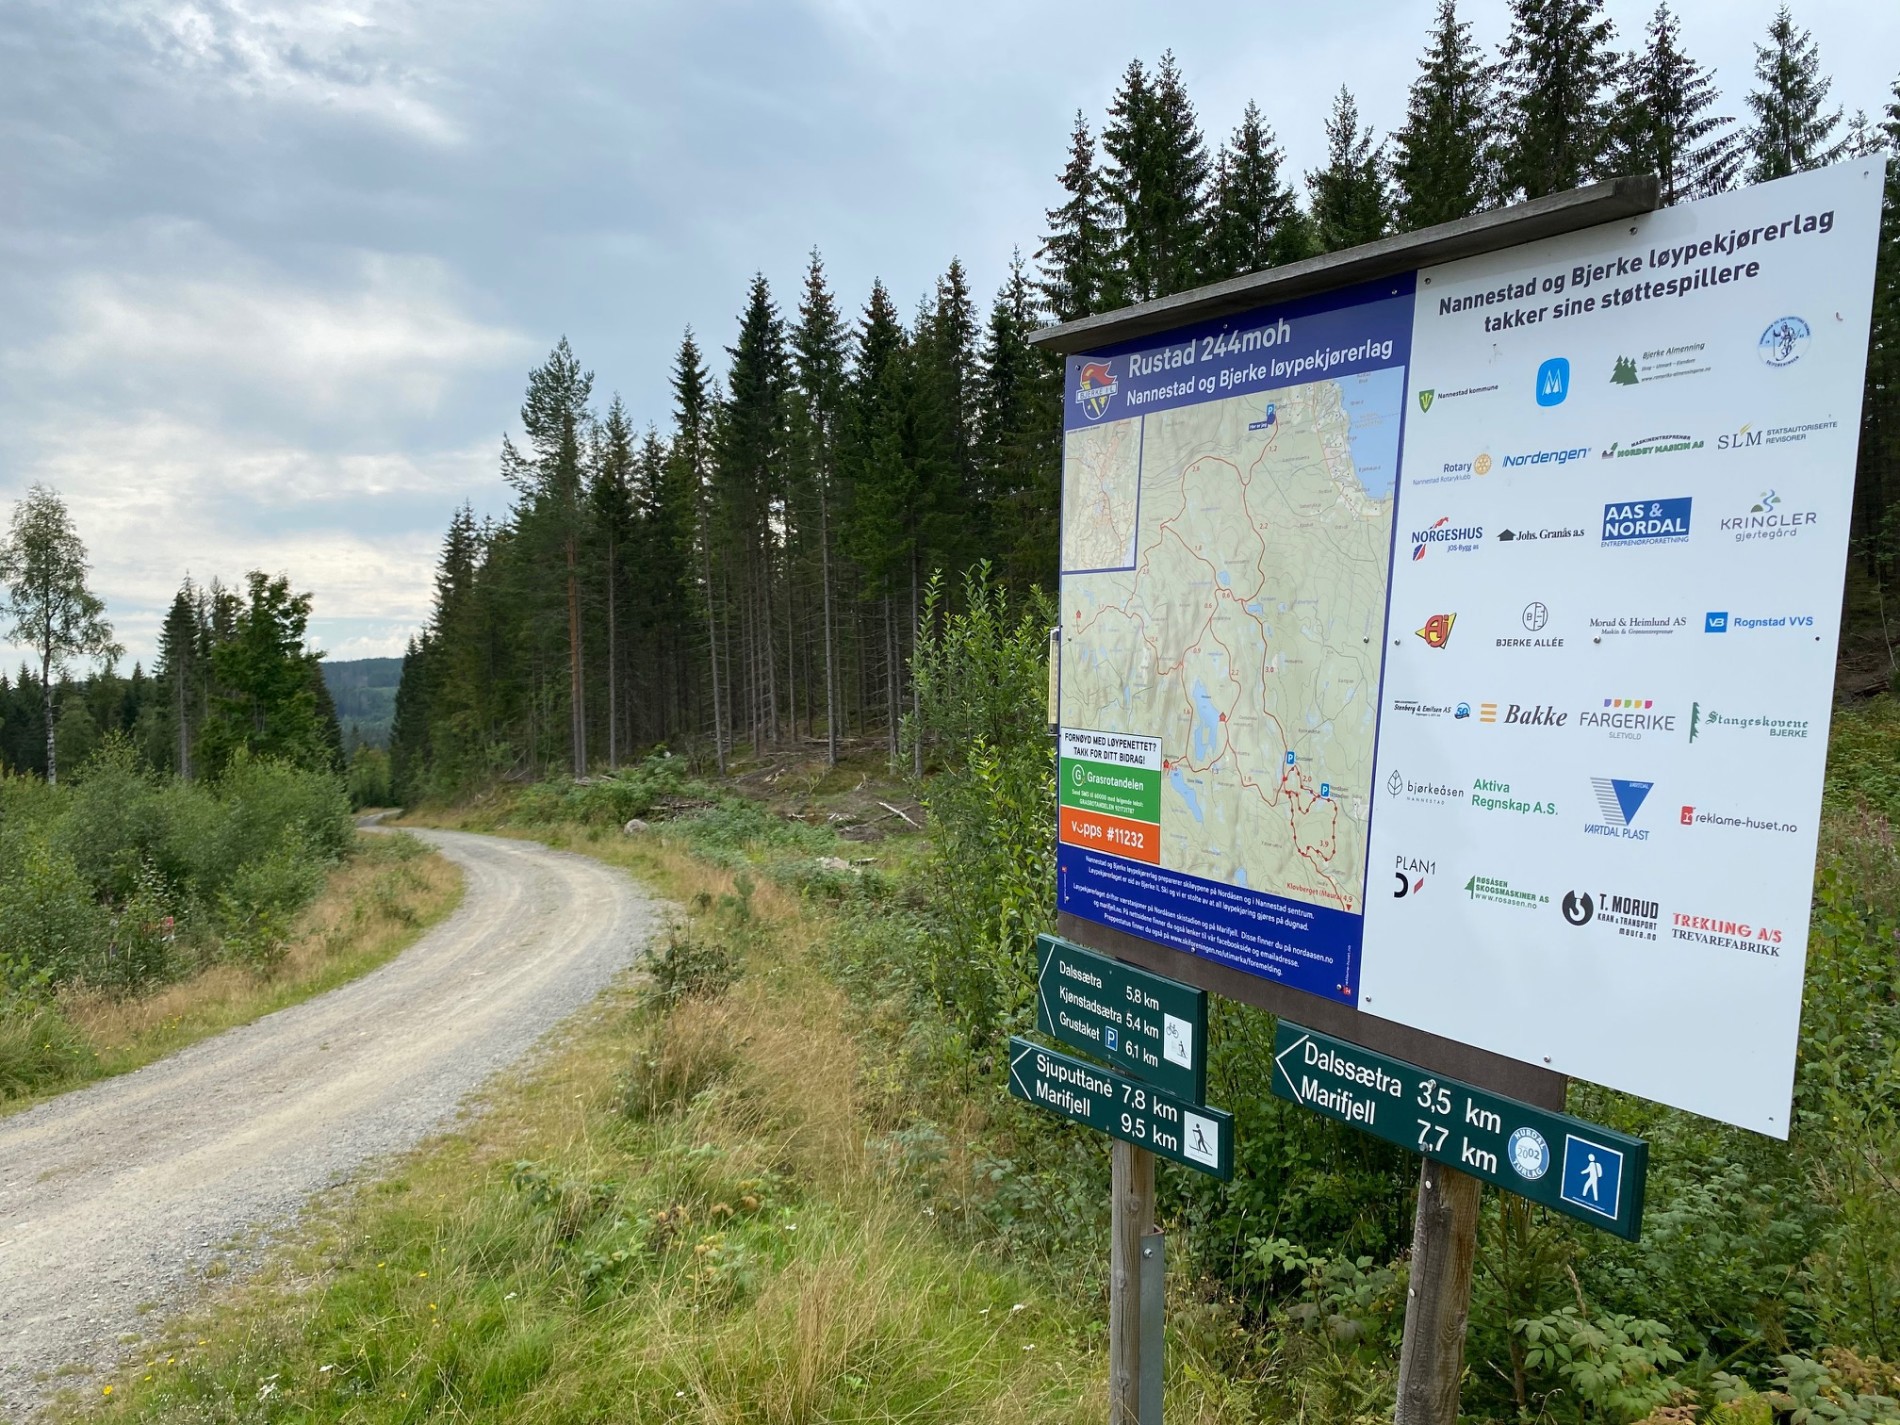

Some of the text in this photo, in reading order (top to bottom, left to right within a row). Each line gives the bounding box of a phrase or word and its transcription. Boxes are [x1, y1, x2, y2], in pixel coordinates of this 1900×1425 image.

[1439, 210, 1834, 316] Nannestad og Bjerke løypekjørerlag
[1484, 261, 1760, 332] takker sine støttespillere
[1128, 318, 1290, 378] Rustad 244moh
[1642, 342, 1706, 360] Bjerke Almenning
[1126, 339, 1393, 406] Nannestad og Bjerke løypekjørerlag
[1438, 384, 1498, 400] Nannestad kommune
[1718, 421, 1838, 450] SLM STATSAUTORISERTE
[1766, 434, 1806, 444] REVISORER
[1654, 442, 1692, 454] MASKIN
[1692, 440, 1704, 450] AS
[1503, 448, 1588, 468] Nordengen
[1444, 462, 1472, 474] Rotary
[1413, 474, 1471, 486] Nannestad Rotaryklubb
[1606, 502, 1664, 520] AAS &
[1604, 518, 1687, 538] NORDAL
[1720, 512, 1818, 530] KRINGLER
[1412, 526, 1483, 544] NORGESHUS
[1516, 528, 1585, 541] Johs. Granås a.s
[1600, 536, 1689, 548] ENTREPRENØRFORRETNING
[1736, 527, 1797, 542] gjestegård
[1590, 616, 1687, 628] Morud & Heimlund AS
[1734, 617, 1786, 628] Rognstad
[1789, 616, 1814, 626] VVS
[1496, 636, 1564, 648] BJERKE ALLÉE
[1457, 708, 1469, 716] 50
[1504, 704, 1568, 726] Bakke
[1580, 712, 1676, 731] FARGERIKE
[1705, 710, 1808, 729] Stangeskovene
[1065, 732, 1156, 752] FORNØYD MED LØYPENETTET?
[1608, 732, 1642, 740] SLETVOLD
[1769, 728, 1808, 738] BJERKE
[1074, 746, 1146, 765] TAKK FOR DITT BIDRAG!
[1087, 772, 1144, 791] Grasrotandelen
[1407, 780, 1464, 798] bjørkeåsen
[1472, 778, 1510, 793] Aktiva
[1406, 796, 1445, 806] NANNESTAD
[1471, 794, 1558, 816] Regnskap A.S.
[1695, 812, 1798, 833] reklame-huset.no
[1106, 826, 1144, 848] #11232
[1584, 824, 1650, 841] VARTDAL PLAST
[1396, 856, 1436, 876] PLAN1
[1476, 876, 1508, 888] RØSÅSEN
[1475, 884, 1550, 904] SKOGSMASKINER AS
[1475, 892, 1538, 910] www.rosasen.no
[1599, 893, 1659, 920] T. MORUD
[1598, 912, 1614, 923] KRAN
[1620, 916, 1658, 931] TRANSPORT
[1672, 912, 1783, 943] TREKLING A/S
[1672, 928, 1780, 958] TREVAREFABRIKK
[1059, 961, 1160, 1011] Dalssætra 5,8 km
[1059, 986, 1159, 1039] Kjønstadsætra 5,4 km
[1059, 1012, 1158, 1068] Grustaket P 6,1 km
[1036, 1054, 1178, 1122] Sjuputtane 7,8 km
[1304, 1041, 1501, 1134] Dalssætra 3,5 km
[1036, 1079, 1177, 1152] Marifjell 9,5 km
[1300, 1075, 1498, 1174] Marifjell 7,7 km
[1514, 1129, 1546, 1150] HURDAL
[1517, 1148, 1540, 1160] 2002
[1513, 1159, 1543, 1178] TURLAG
